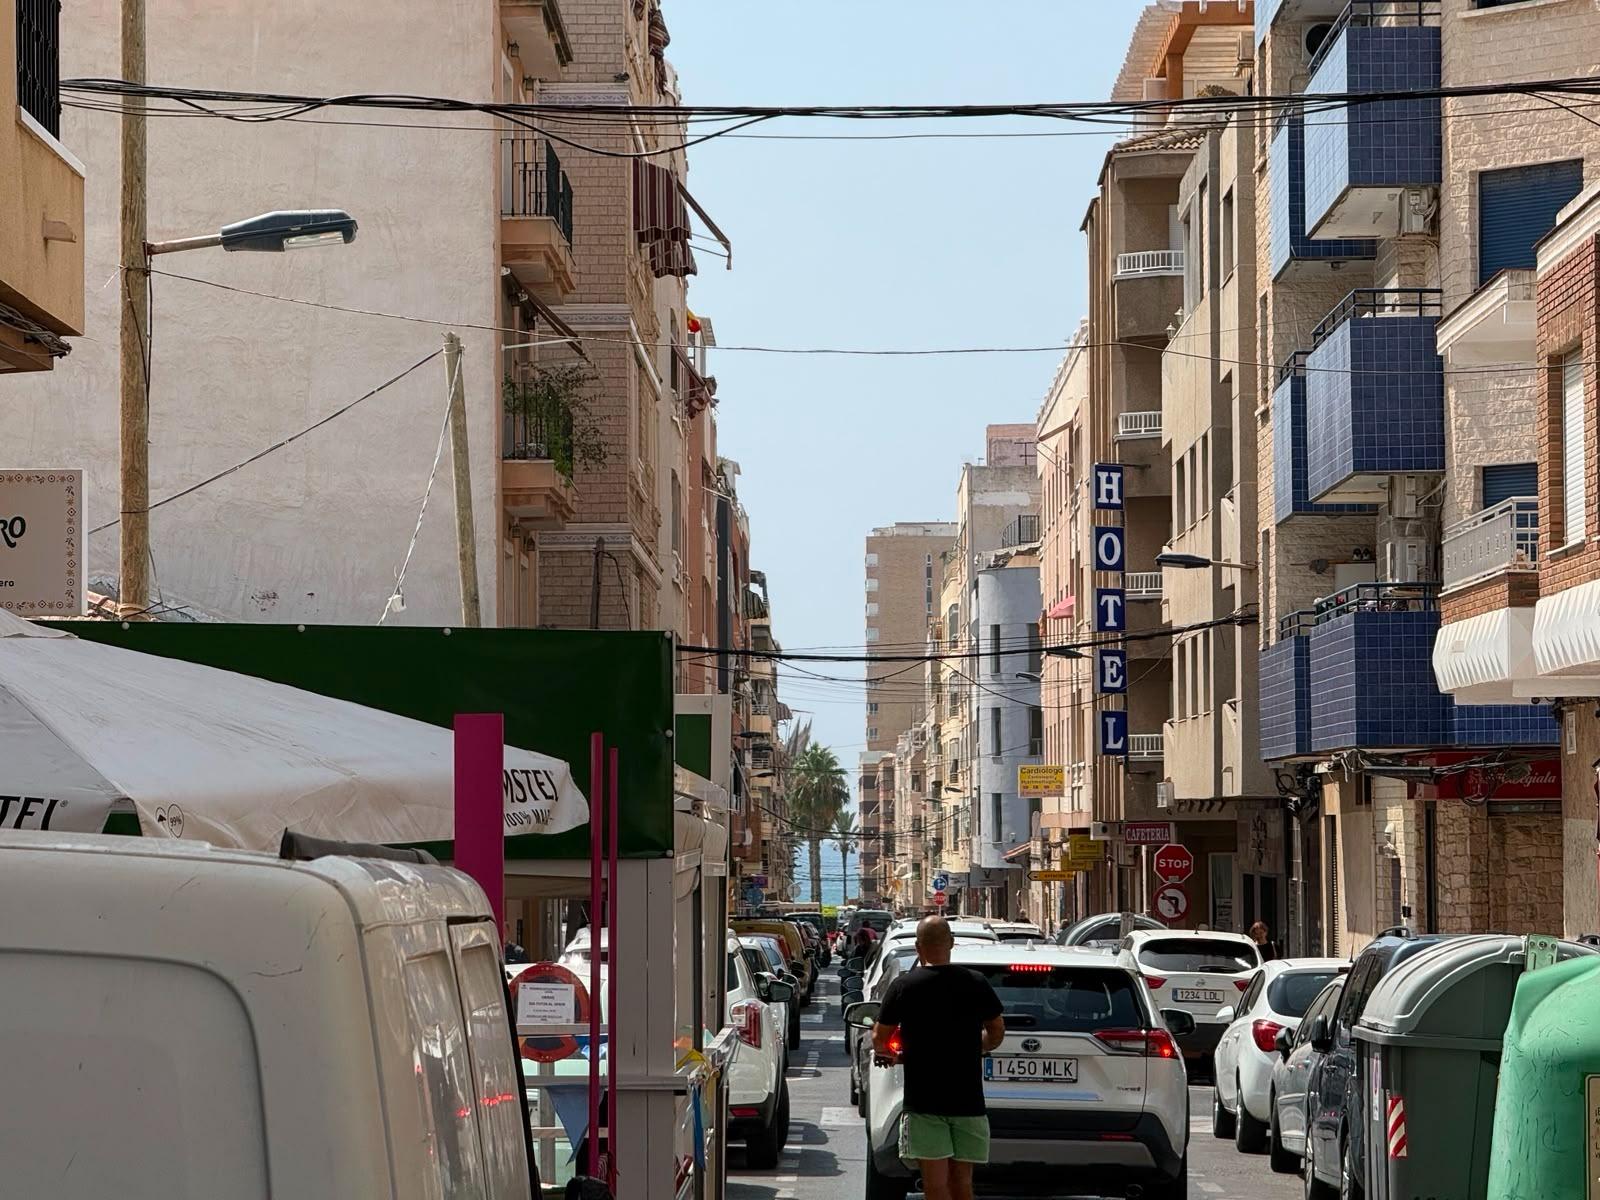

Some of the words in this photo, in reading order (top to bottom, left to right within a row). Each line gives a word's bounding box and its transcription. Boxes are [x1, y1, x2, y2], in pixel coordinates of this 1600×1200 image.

[1097, 471, 1124, 750] HOTEL
[1126, 828, 1170, 841] CAFETERIA
[1158, 858, 1190, 869] STOP
[1180, 991, 1200, 1000] 1234
[997, 1060, 1038, 1076] 1450
[1042, 1061, 1074, 1077] MLK
